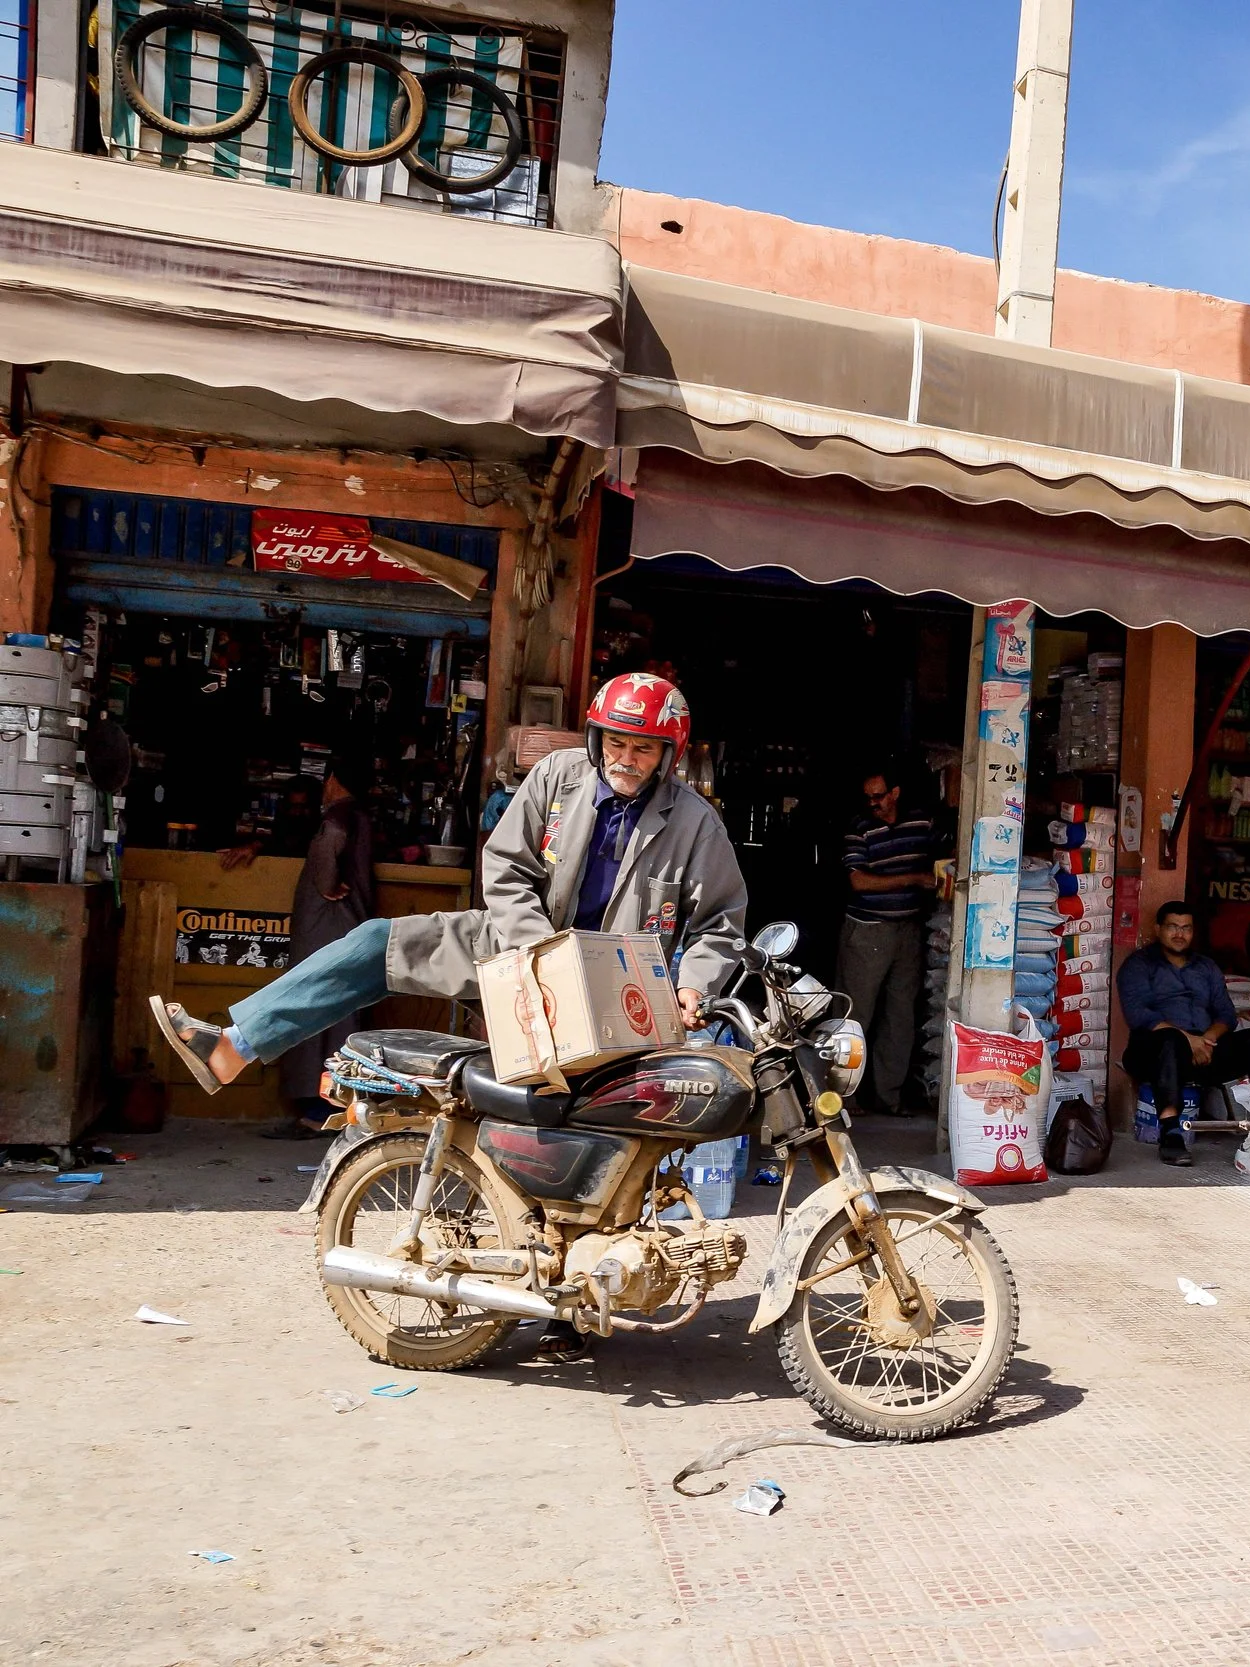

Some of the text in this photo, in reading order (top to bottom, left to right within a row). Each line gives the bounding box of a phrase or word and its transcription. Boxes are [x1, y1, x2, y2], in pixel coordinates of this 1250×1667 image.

[272, 522, 315, 539] زيوت
[256, 538, 368, 567] بترومين
[1007, 655, 1027, 664] ARIEL
[237, 934, 262, 942] THE
[981, 1047, 1006, 1057] tendre
[514, 1055, 531, 1064] ucre
[980, 1056, 1028, 1070] Farine de Luxe
[982, 1124, 1029, 1141] Afifa
